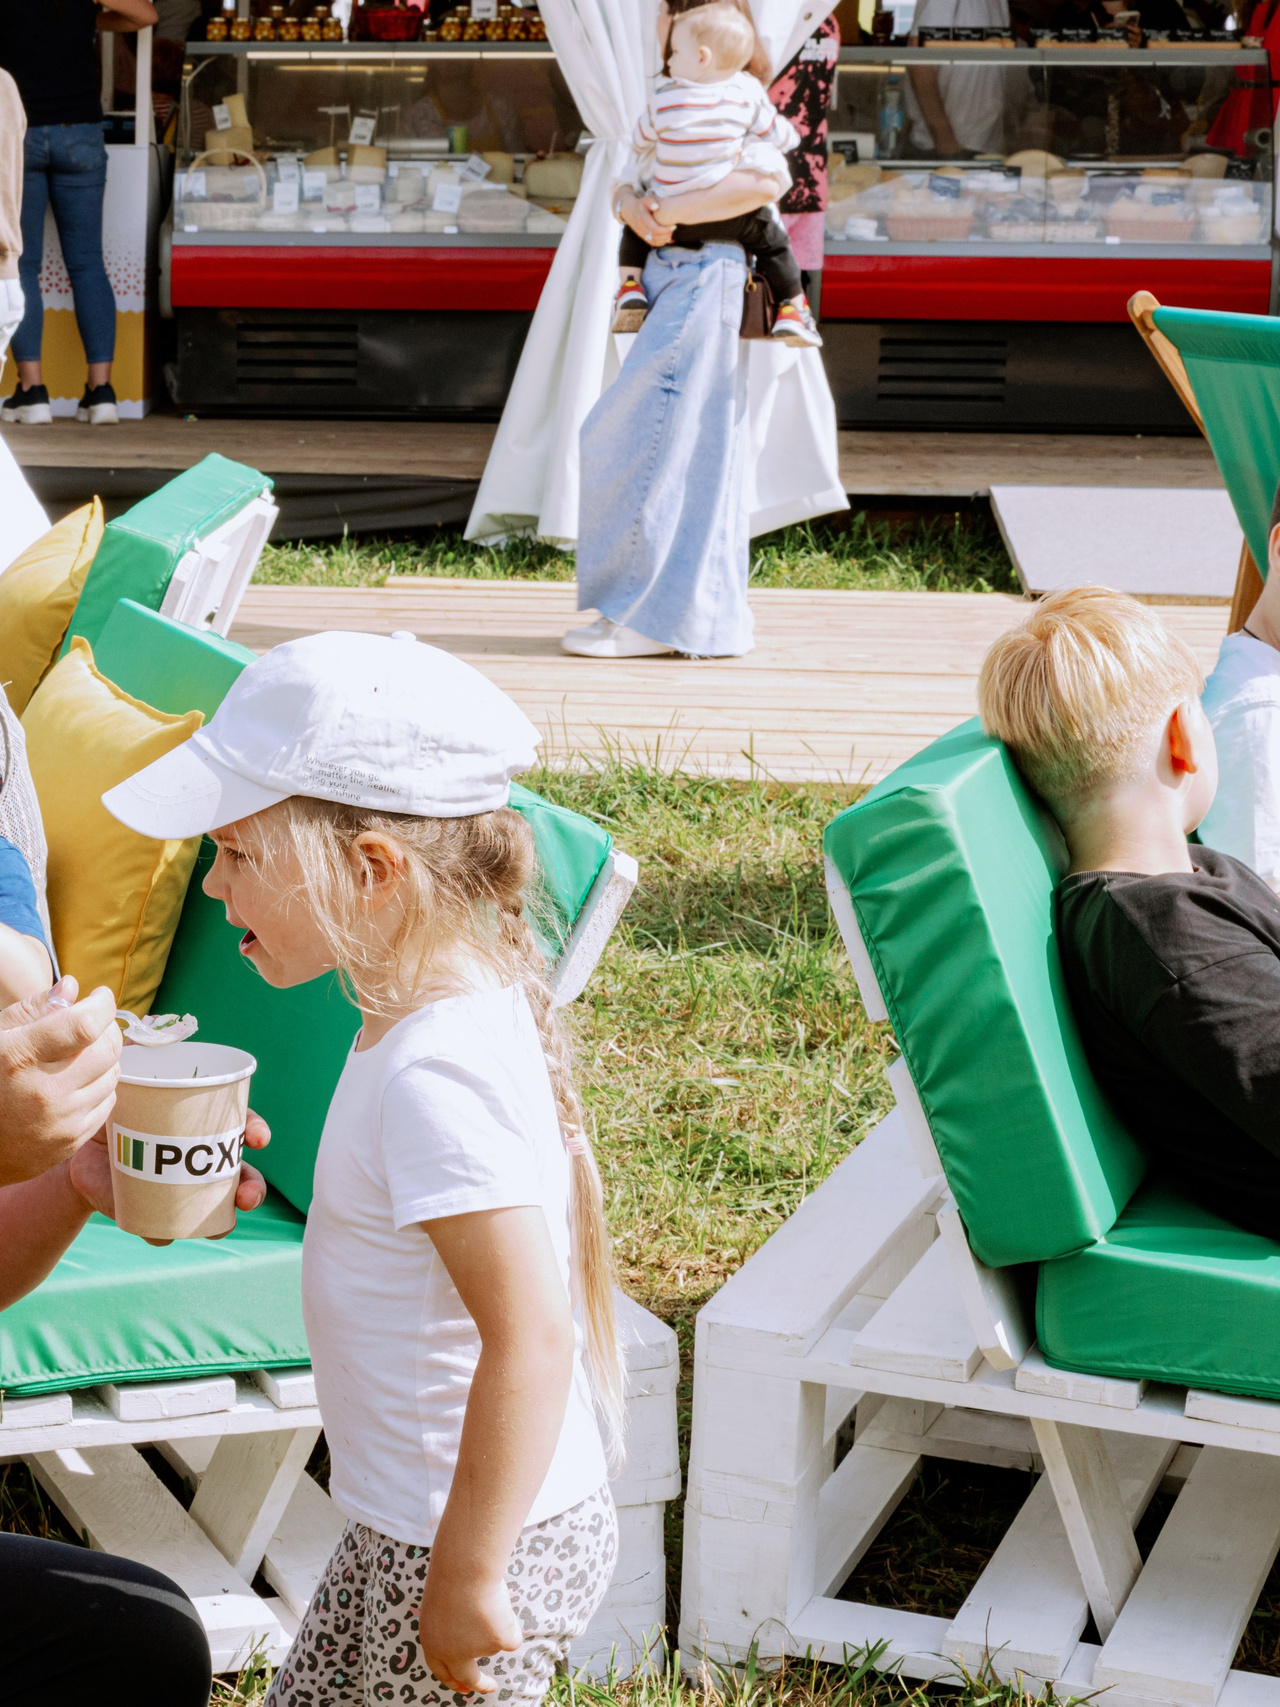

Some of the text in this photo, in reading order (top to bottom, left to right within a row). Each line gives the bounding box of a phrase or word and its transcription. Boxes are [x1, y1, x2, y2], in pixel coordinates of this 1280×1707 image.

[306, 755, 347, 772] Wherever
[349, 766, 366, 778] you
[318, 769, 347, 780] matter
[350, 775, 364, 786] the
